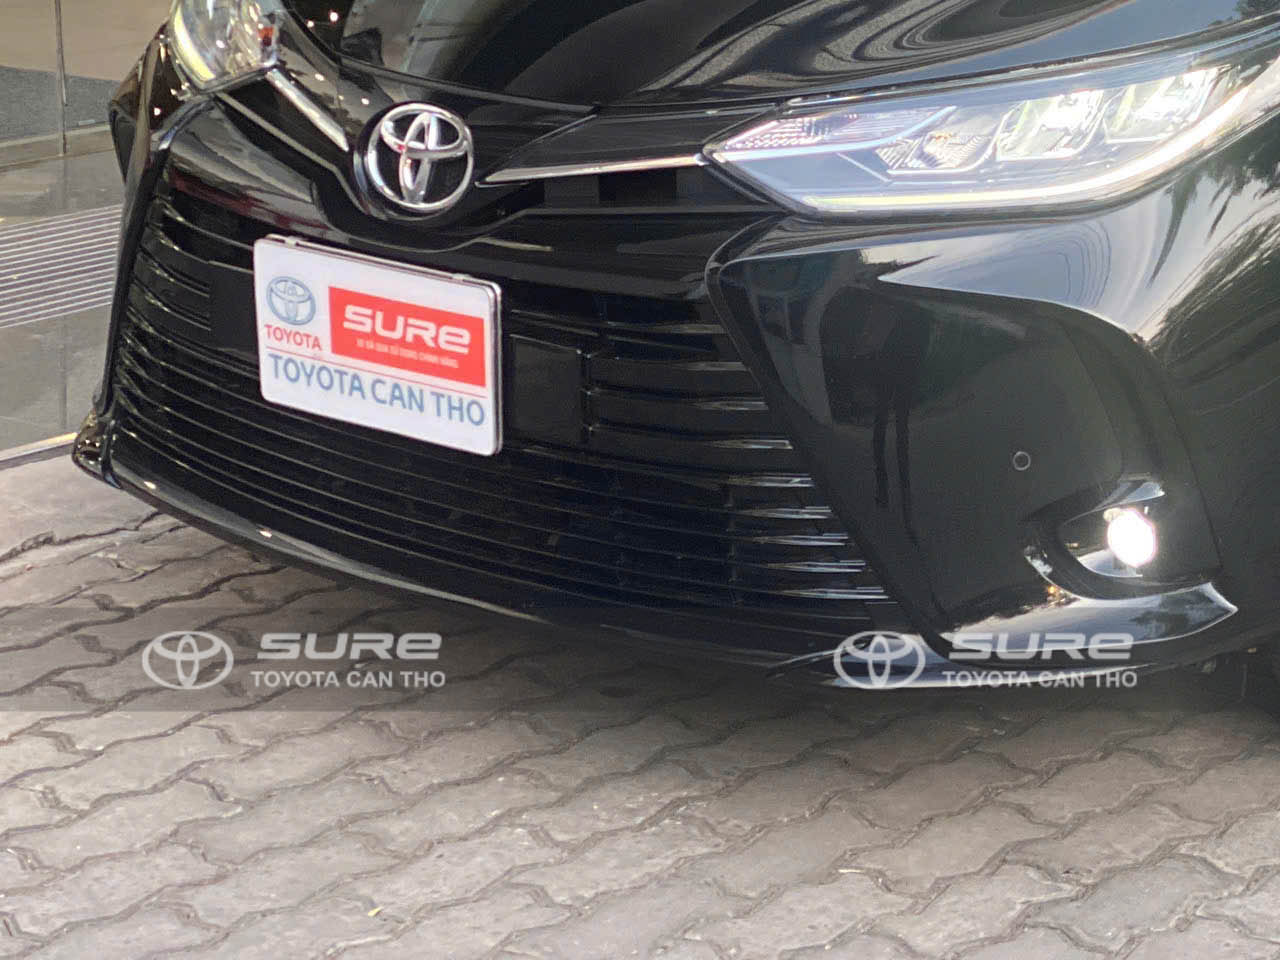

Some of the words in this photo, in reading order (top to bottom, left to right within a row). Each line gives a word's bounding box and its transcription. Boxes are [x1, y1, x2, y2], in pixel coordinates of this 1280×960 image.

[264, 324, 322, 351] TOYOTA
[268, 353, 366, 401] TOYOTA
[371, 379, 425, 420] CAN
[430, 391, 485, 426] THO
